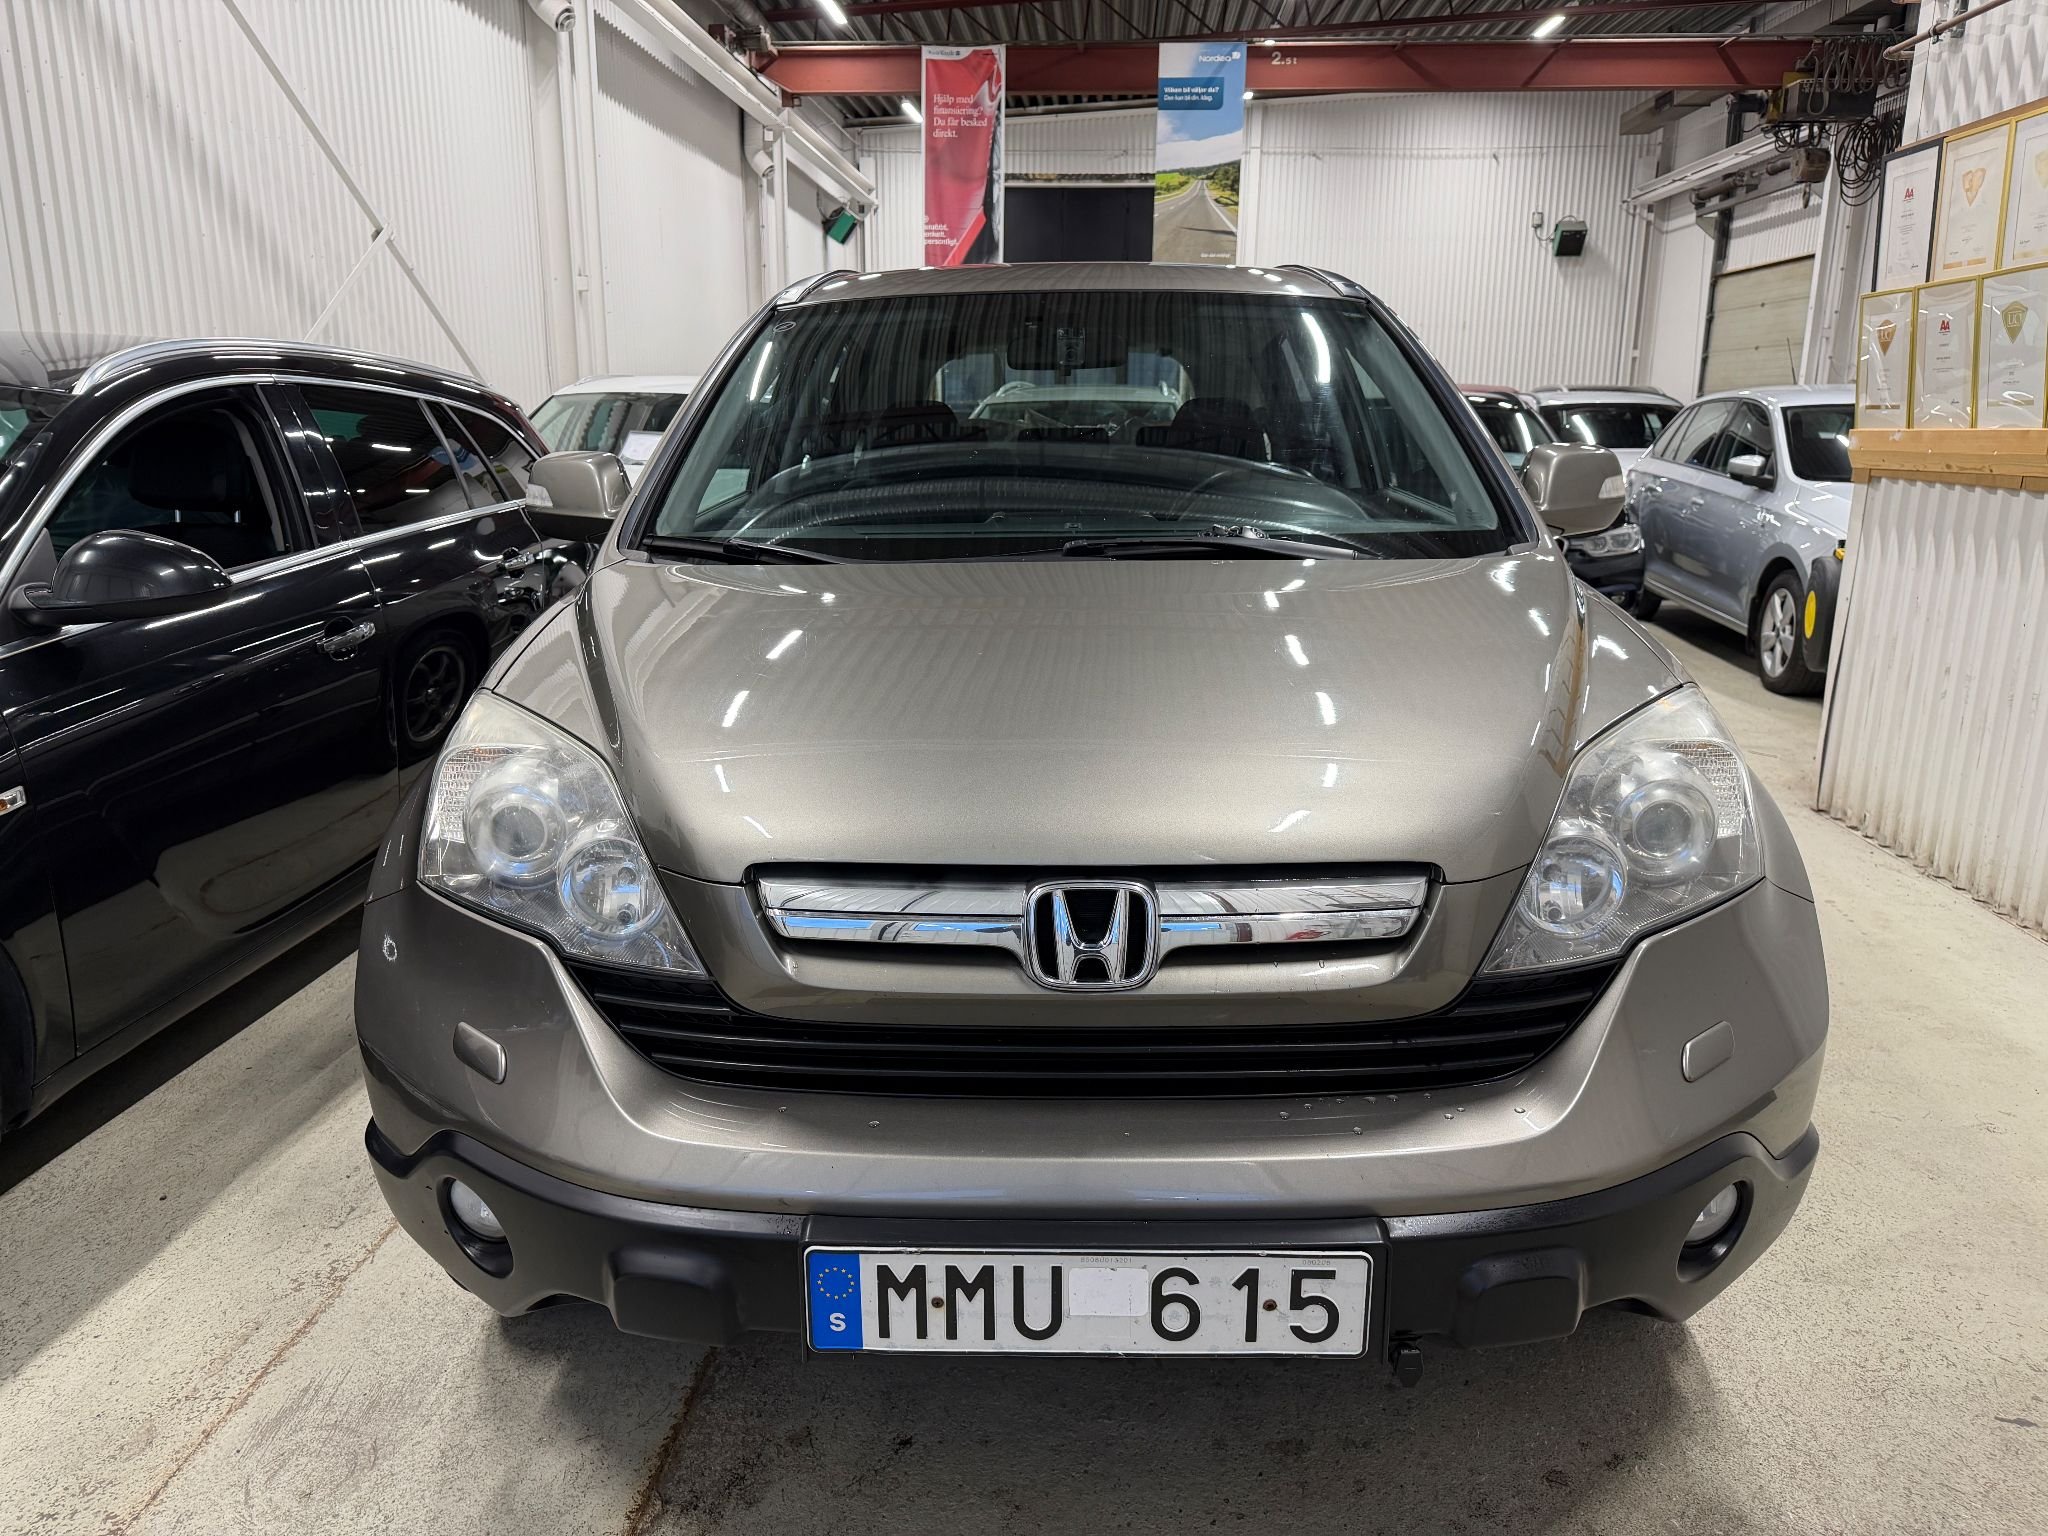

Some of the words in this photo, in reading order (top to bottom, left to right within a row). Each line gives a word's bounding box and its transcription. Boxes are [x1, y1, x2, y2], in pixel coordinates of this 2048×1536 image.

[1199, 54, 1232, 62] Nordea
[933, 93, 954, 104] Hjälp
[956, 94, 974, 104] med
[933, 105, 984, 117] finansiering?
[933, 116, 946, 126] Du
[947, 116, 960, 126] får
[960, 117, 988, 127] besked
[932, 129, 958, 138] direkt.
[876, 1264, 1063, 1341] MMU
[1150, 1267, 1340, 1343] 615
[829, 1311, 847, 1332] S
